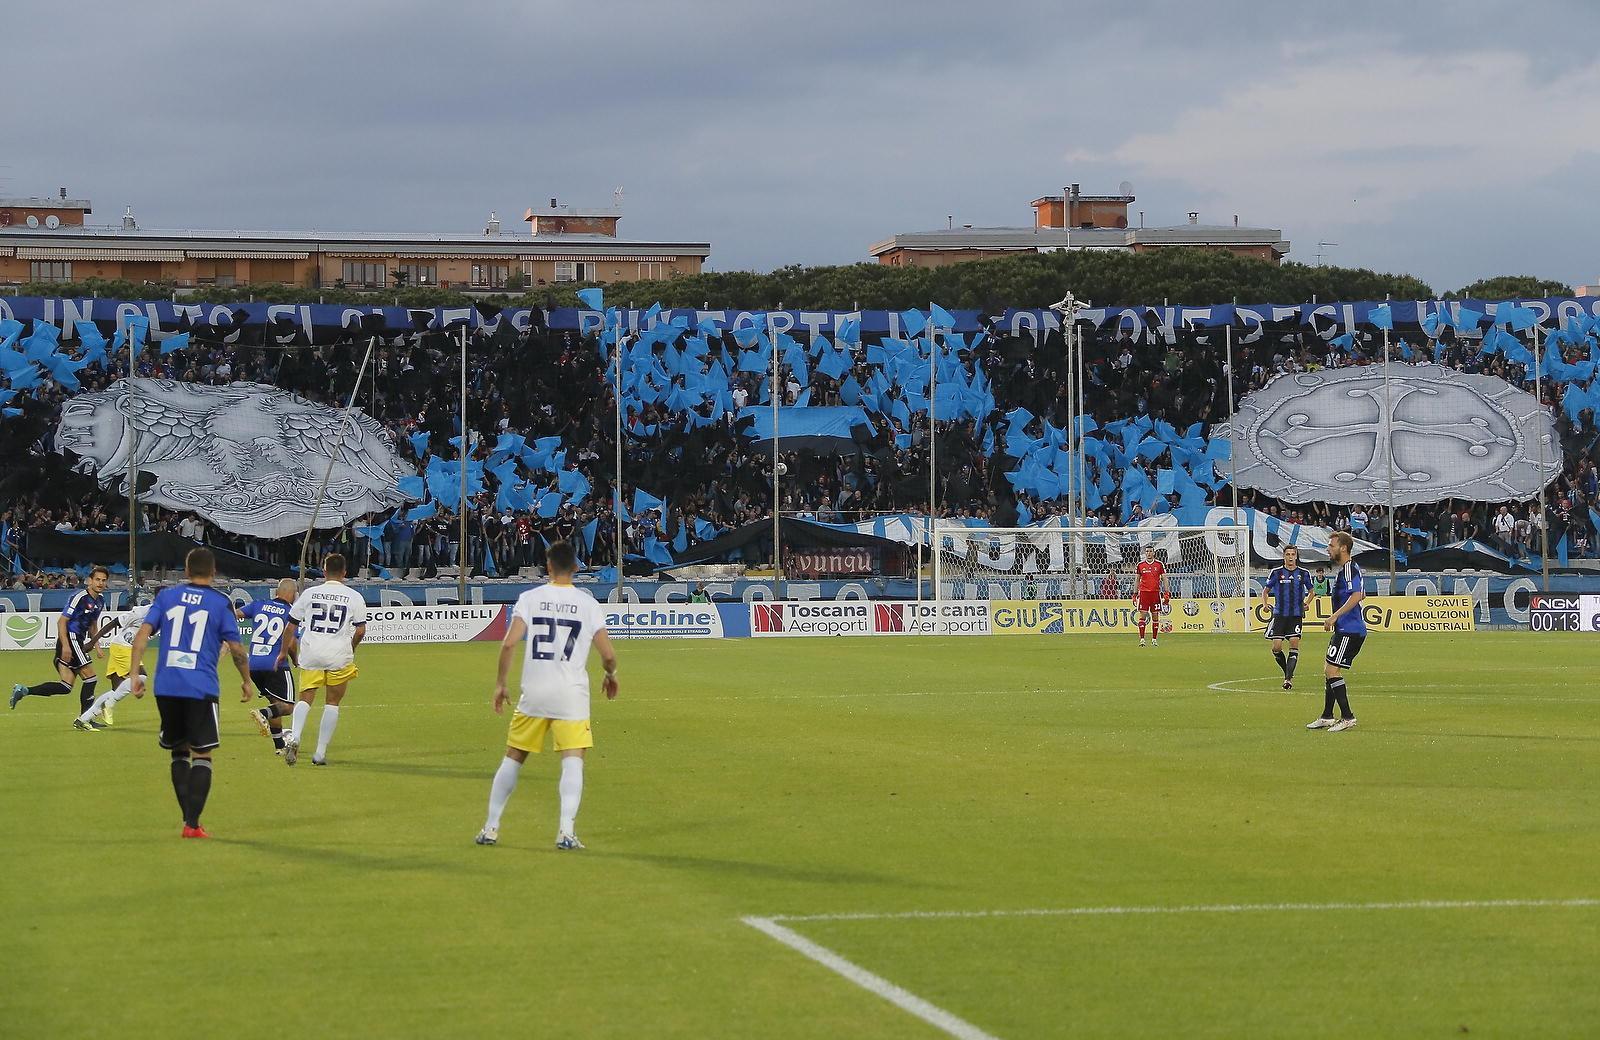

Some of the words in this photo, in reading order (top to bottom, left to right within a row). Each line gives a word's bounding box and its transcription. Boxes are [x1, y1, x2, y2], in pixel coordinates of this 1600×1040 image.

[181, 592, 202, 605] LISI
[311, 593, 350, 603] BENEDETTI
[1427, 598, 1459, 607] SCAVI
[1462, 598, 1469, 607] E
[1538, 598, 1580, 609] NGM
[261, 604, 286, 615] NEGRO
[556, 603, 578, 614] VITO
[788, 604, 867, 617] Toscana
[908, 604, 988, 617] Toscana
[310, 602, 347, 634] 29
[400, 609, 492, 620] MARTINELLI
[605, 610, 711, 626] acchine
[1399, 610, 1470, 619] DEMOLIZIONI
[406, 623, 427, 631] CON
[439, 621, 470, 631] CUORE
[788, 618, 868, 634] Aeroporti
[1181, 622, 1204, 630] Jeep
[1402, 622, 1470, 631] INDUSTRIALI
[1531, 612, 1580, 631] 00:13
[165, 605, 209, 652] 11
[251, 613, 285, 646] 29
[1294, 624, 1301, 633] 6
[532, 616, 582, 662] 27
